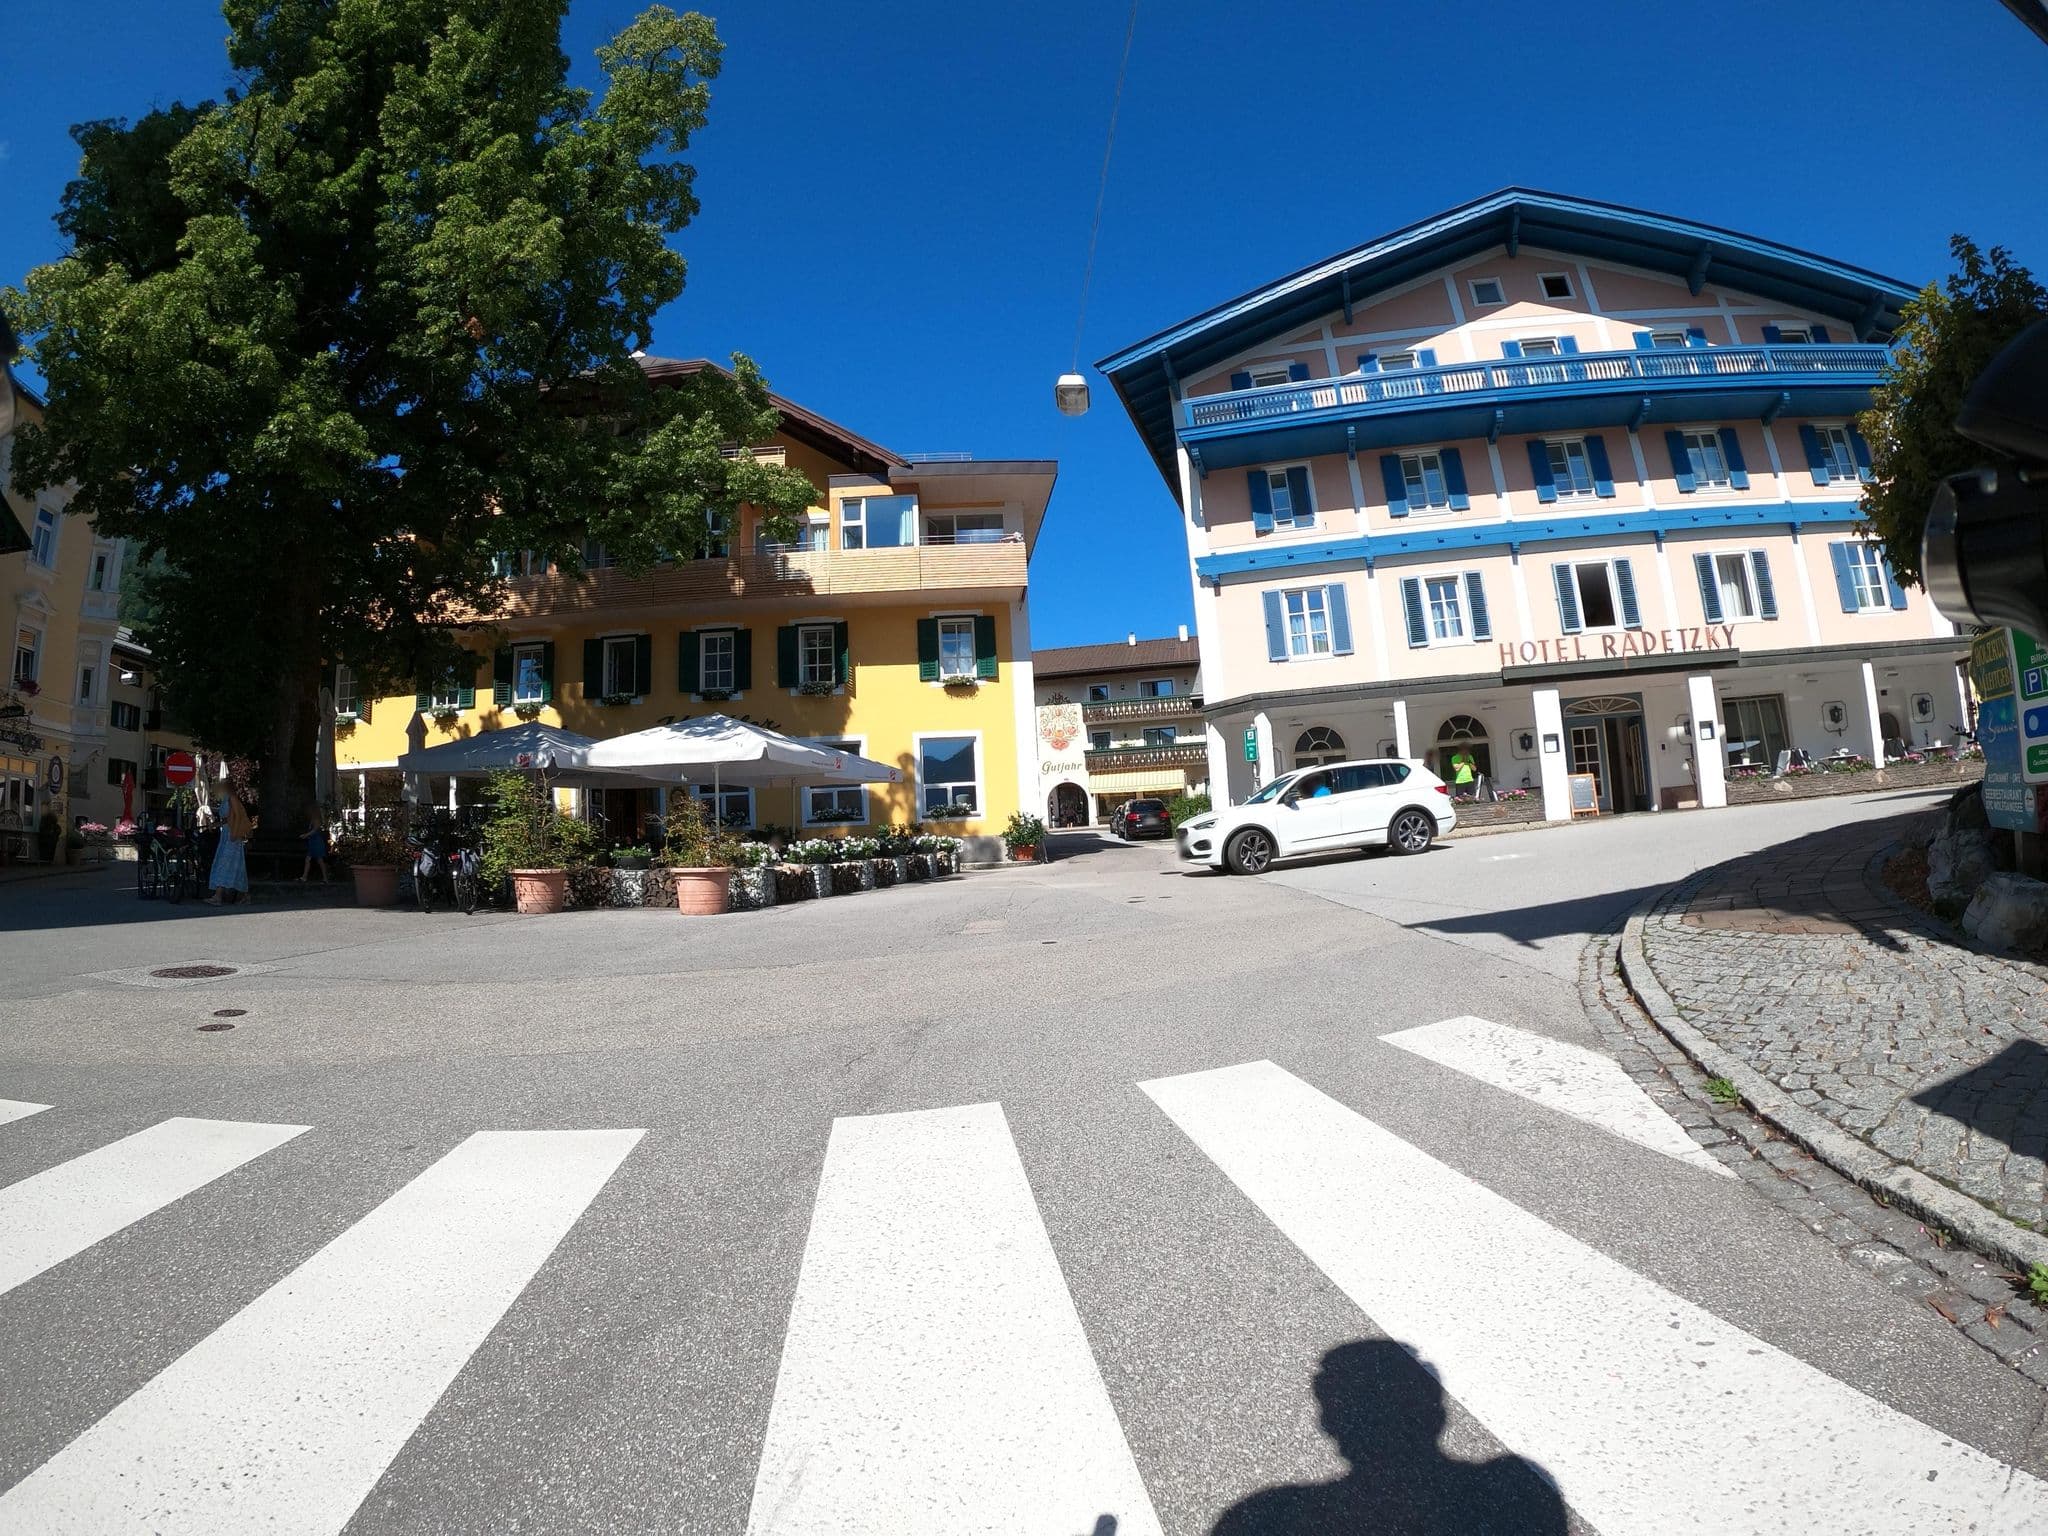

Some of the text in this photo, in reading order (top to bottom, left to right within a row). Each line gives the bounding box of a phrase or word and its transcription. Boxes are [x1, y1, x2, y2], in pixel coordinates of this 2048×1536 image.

[1499, 624, 1735, 666] HOTEL RADETZKY
[2028, 671, 2038, 691] P
[1041, 760, 1082, 775] Gutjahr
